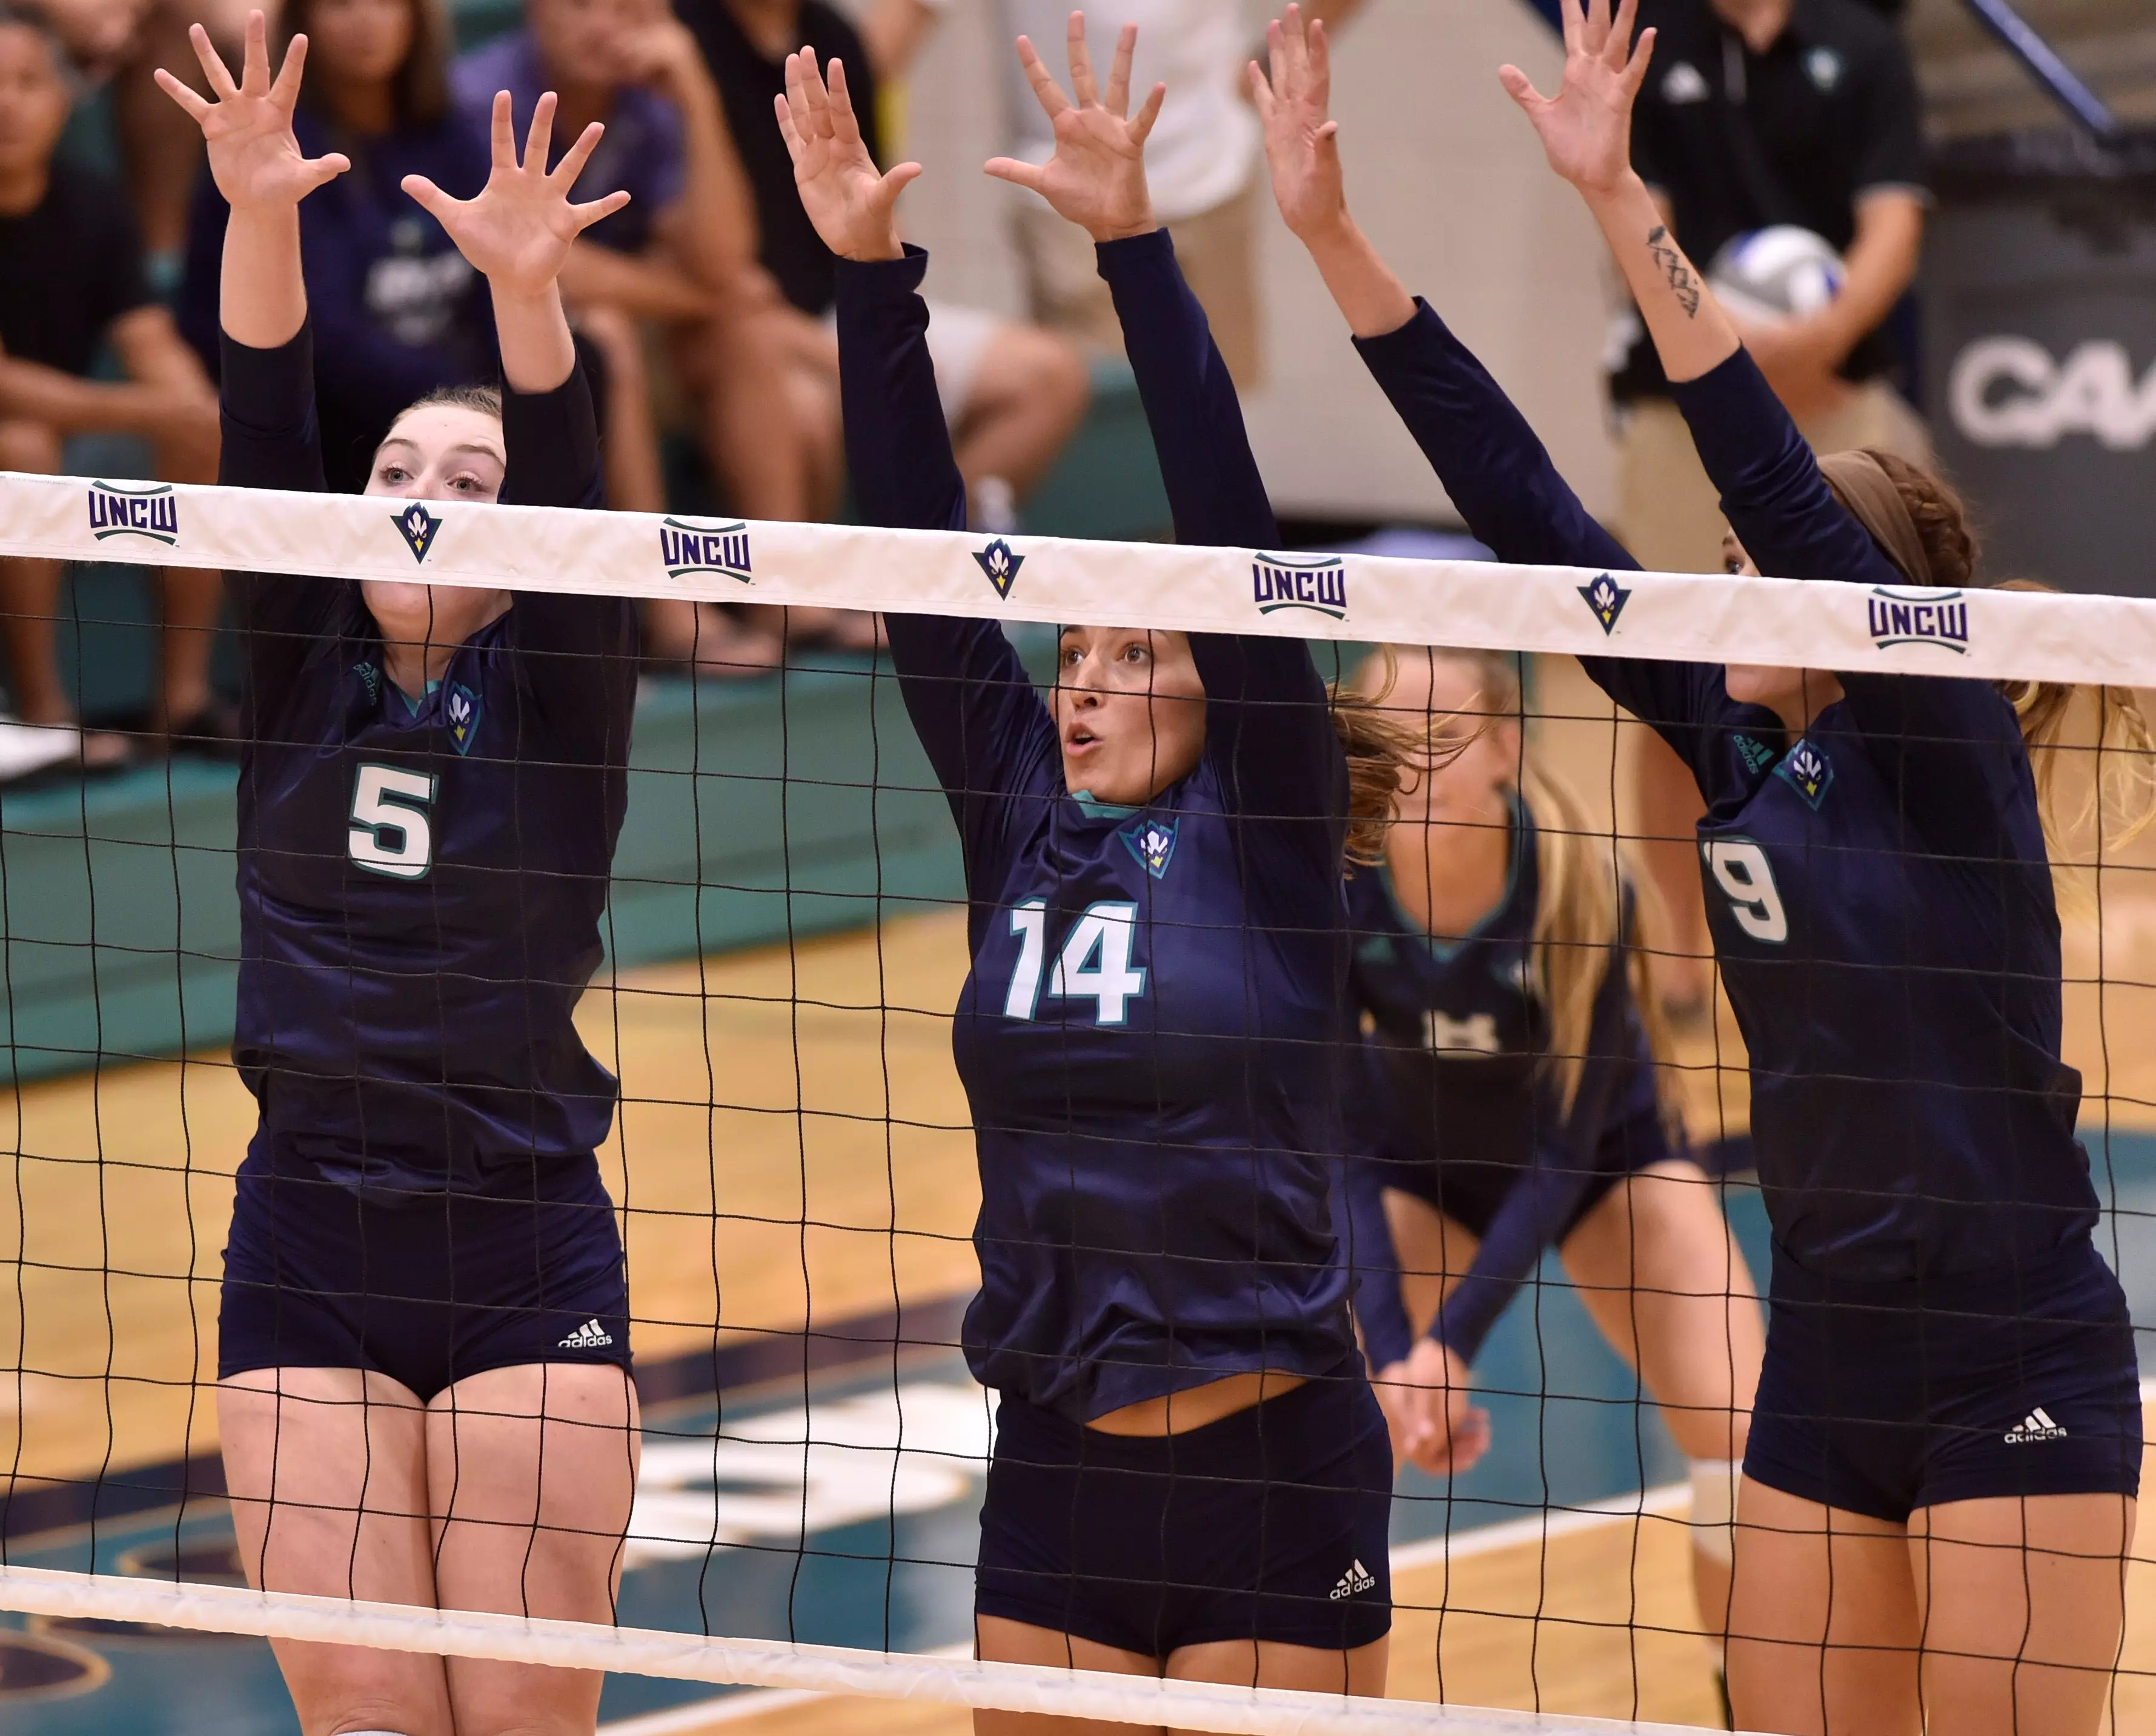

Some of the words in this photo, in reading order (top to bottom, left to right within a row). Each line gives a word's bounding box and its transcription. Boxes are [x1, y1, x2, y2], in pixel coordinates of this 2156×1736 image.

[1949, 334, 2156, 451] CA
[88, 490, 177, 534] UNCW
[660, 528, 752, 572] UNCW
[1252, 563, 1347, 608] UNCW
[1868, 598, 1968, 642] UNCW
[349, 762, 439, 880] 5
[1700, 834, 1789, 945] 9
[1003, 897, 1147, 1025] 14
[1330, 1576, 1375, 1600] addas
